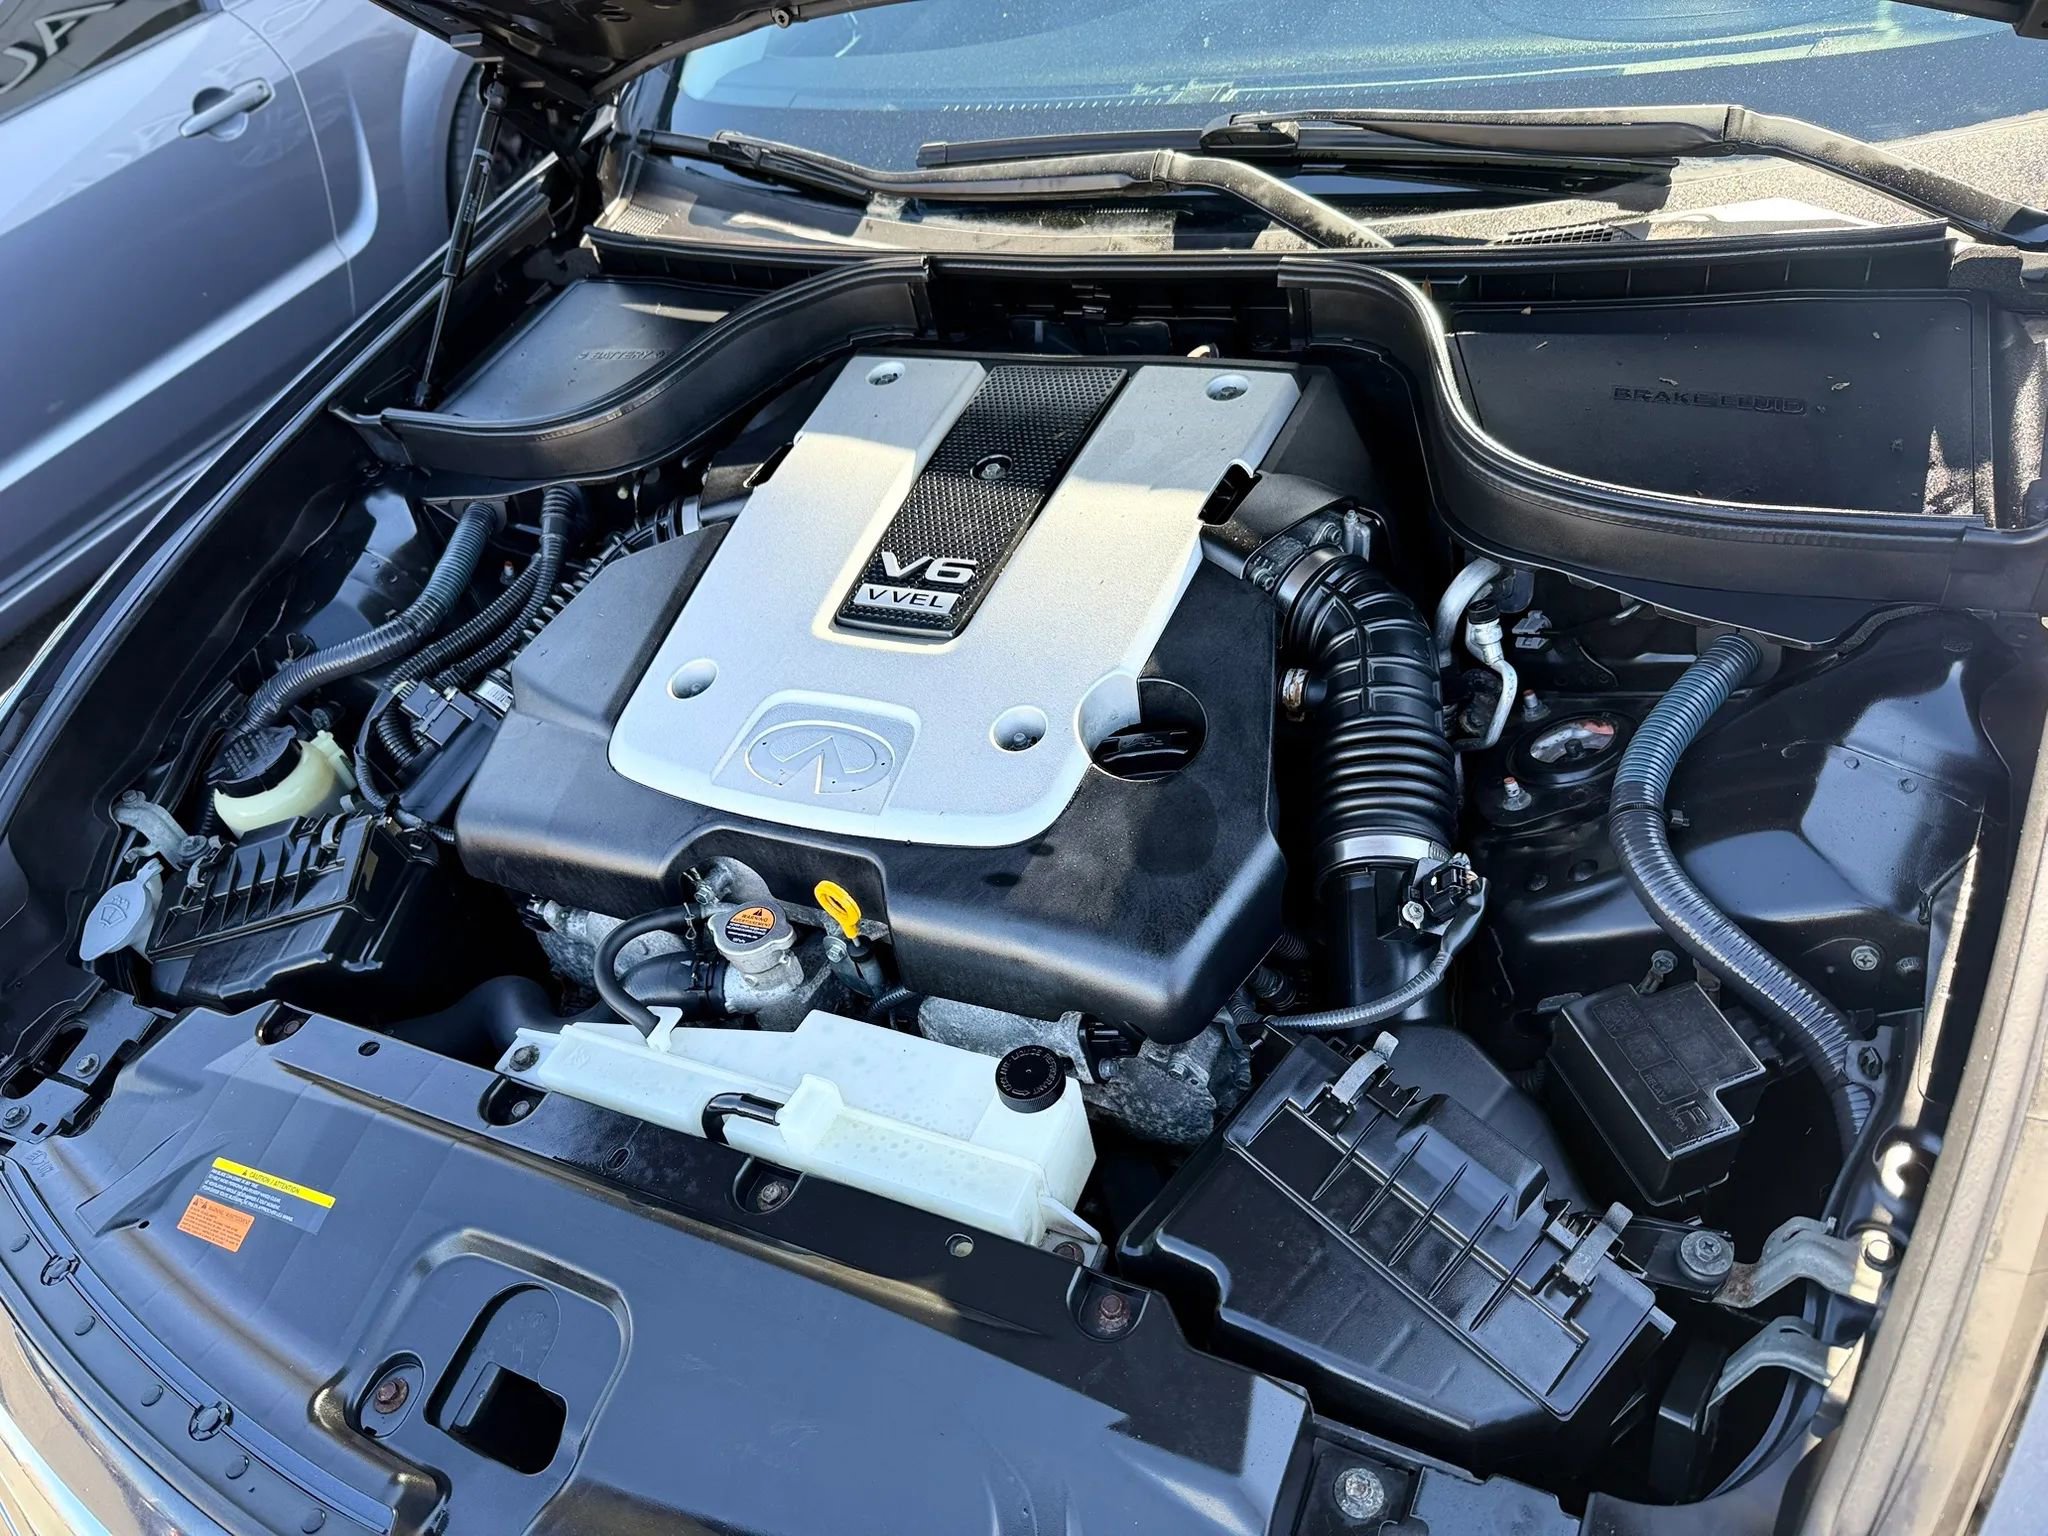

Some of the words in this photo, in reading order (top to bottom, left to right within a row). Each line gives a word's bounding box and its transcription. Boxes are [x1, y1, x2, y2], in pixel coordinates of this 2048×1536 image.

[1611, 386, 1709, 408] BRAKE
[1719, 392, 1807, 416] FLUID
[881, 550, 980, 585] V6
[868, 588, 945, 609] VVEL
[249, 1171, 270, 1184] CAUTION
